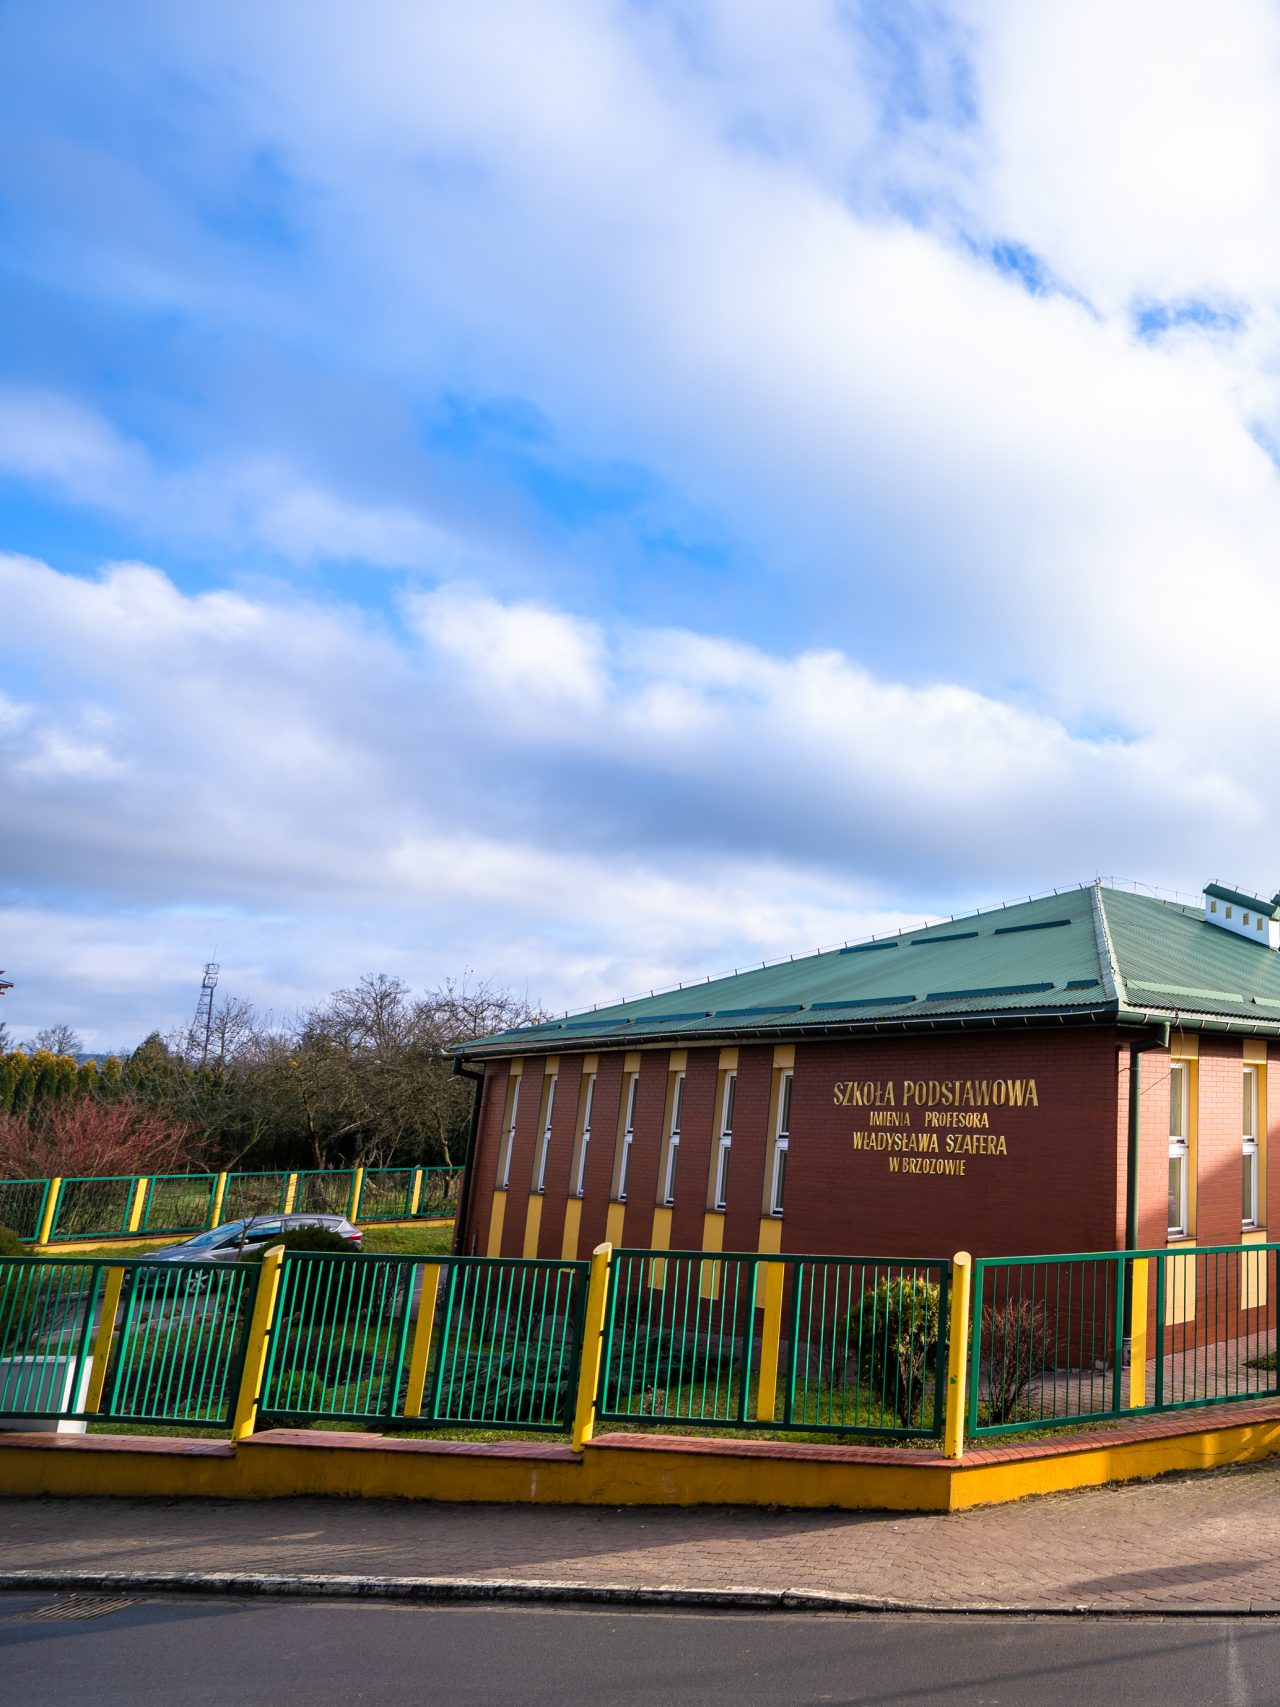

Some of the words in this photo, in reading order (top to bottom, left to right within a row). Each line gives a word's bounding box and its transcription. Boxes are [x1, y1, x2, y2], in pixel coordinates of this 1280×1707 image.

[834, 1081, 895, 1106] SZKOŁA
[902, 1078, 1039, 1107] PODSTAWOWA
[869, 1111, 911, 1127] IMIENIA
[924, 1112, 989, 1128] PROFESORA
[853, 1131, 939, 1153] WŁADYSŁAWA
[945, 1134, 1008, 1156] SZAFERA
[889, 1157, 900, 1173] W
[902, 1157, 966, 1176] BRZOZOWIE
